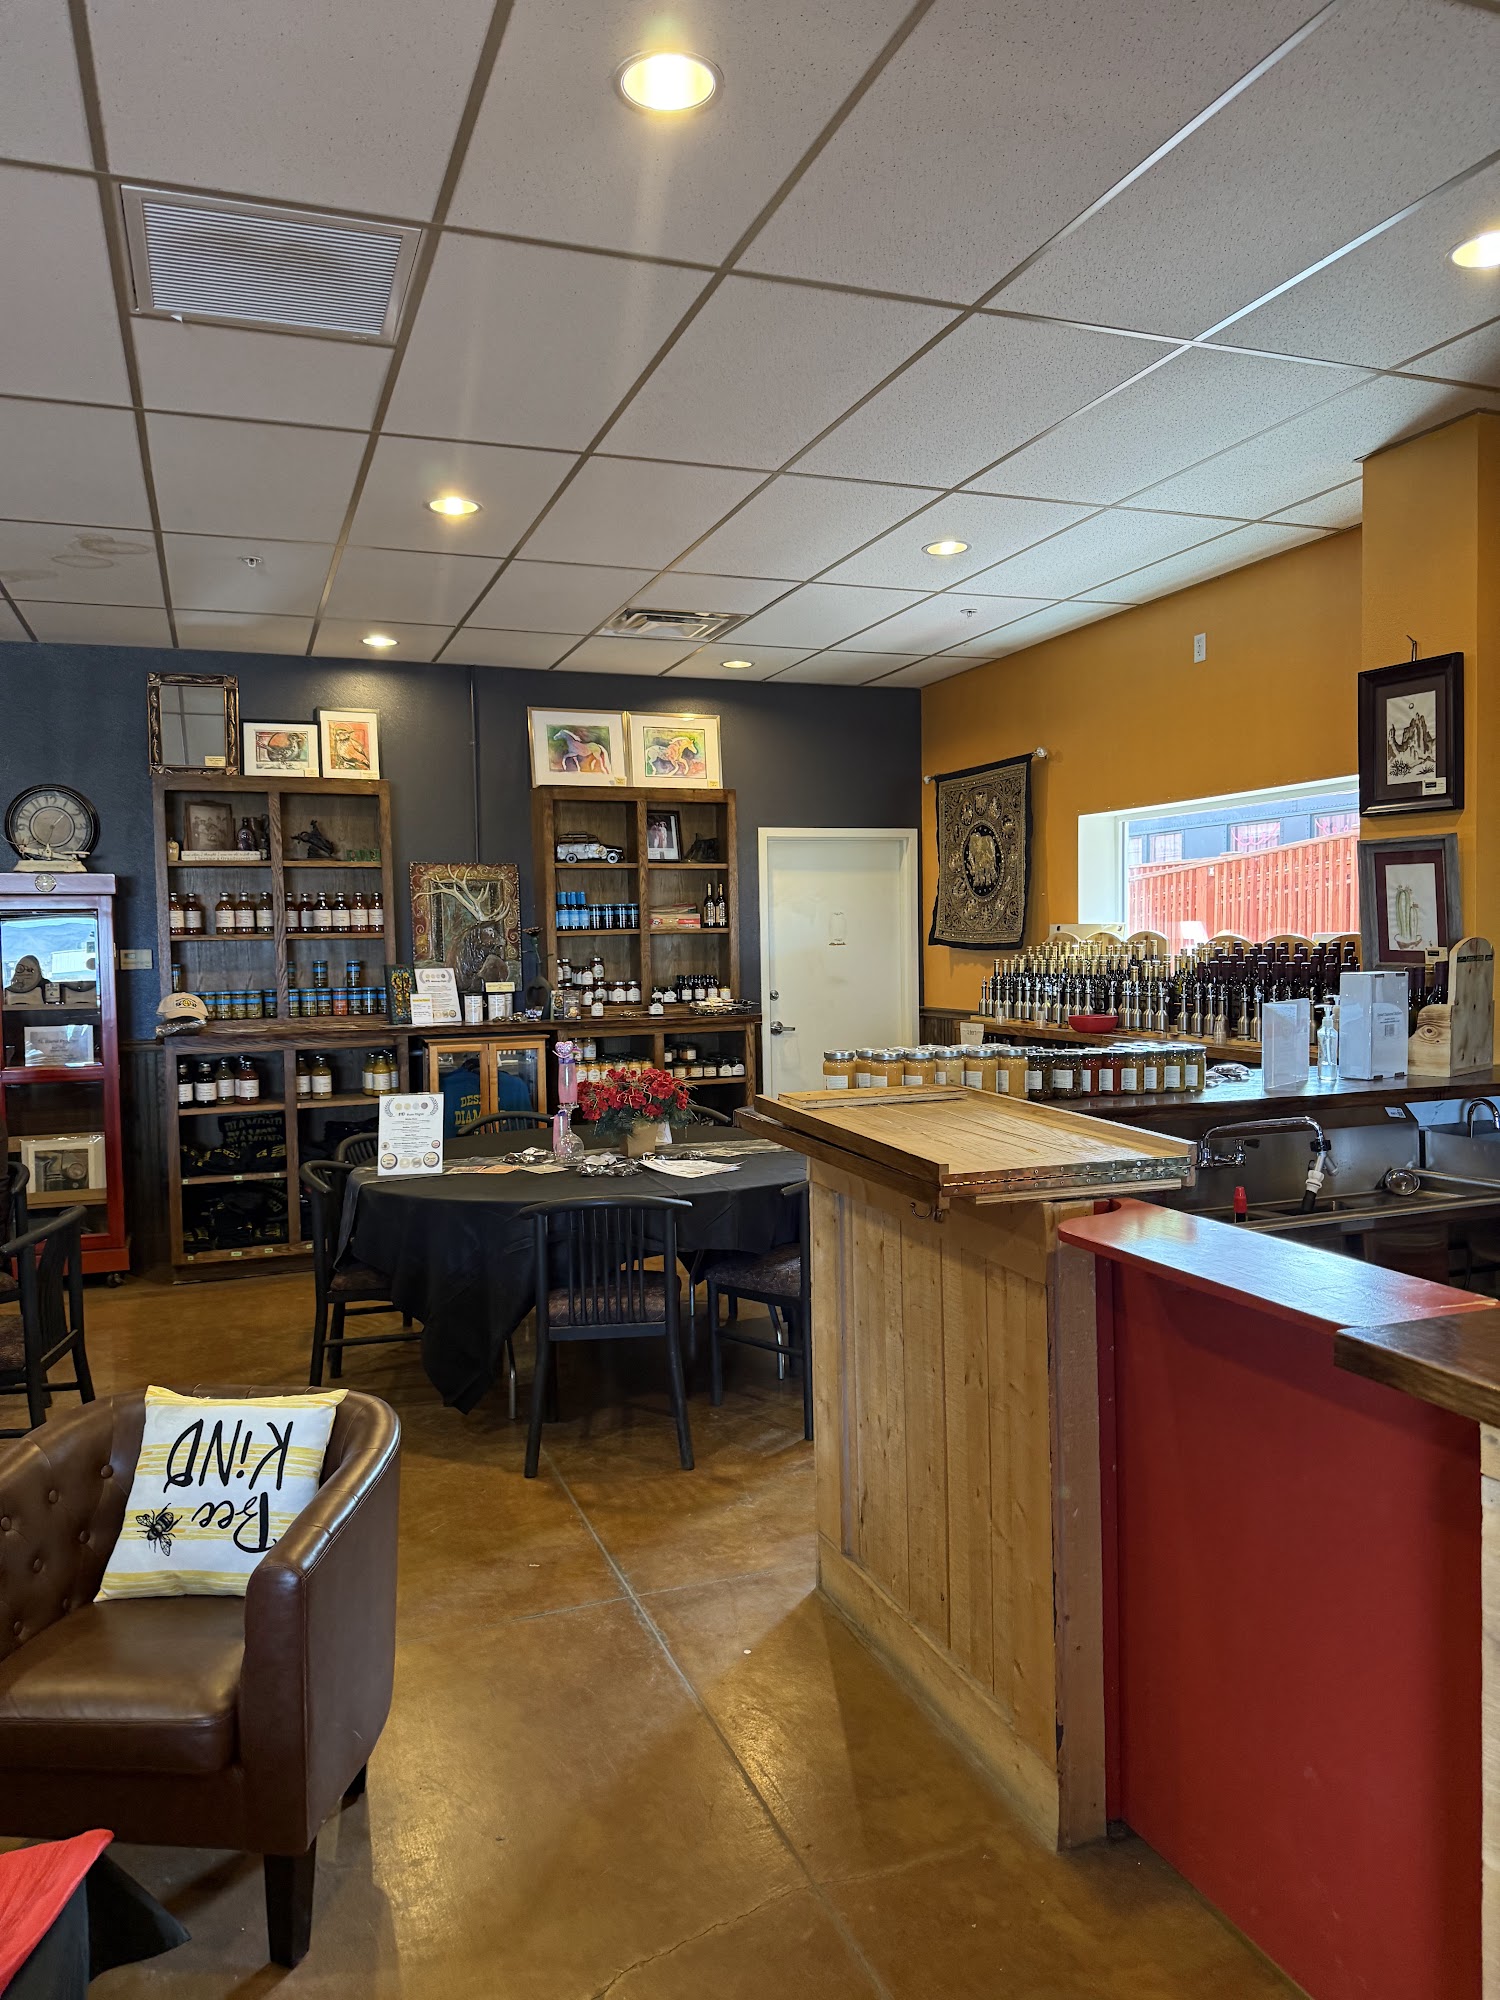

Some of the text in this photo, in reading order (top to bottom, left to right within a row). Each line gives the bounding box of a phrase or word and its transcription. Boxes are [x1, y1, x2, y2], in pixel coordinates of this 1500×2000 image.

[460, 1094, 481, 1108] DES
[454, 1109, 482, 1125] DIAM
[191, 1491, 278, 1554] Bee
